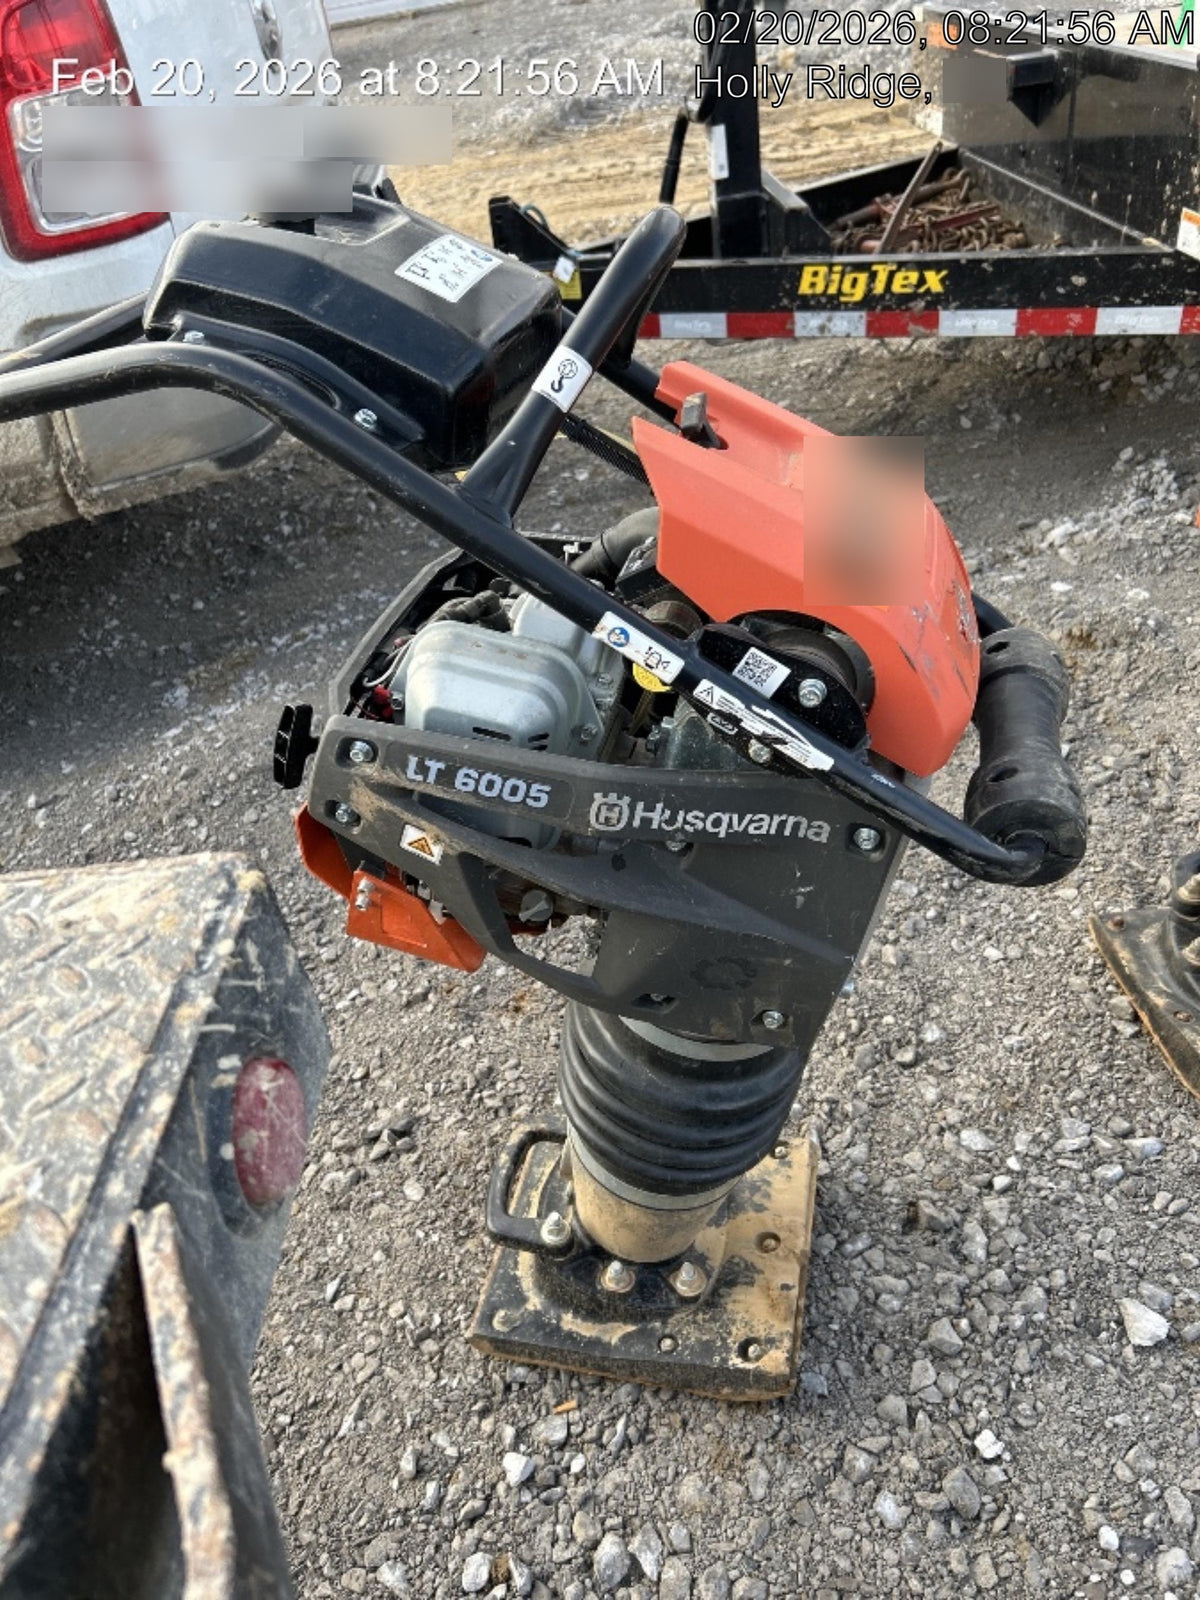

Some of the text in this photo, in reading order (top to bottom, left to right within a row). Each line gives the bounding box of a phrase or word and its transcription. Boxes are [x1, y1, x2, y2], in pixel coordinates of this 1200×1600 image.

[798, 264, 948, 302] BigTex
[406, 755, 552, 808] LT 6005
[632, 801, 832, 843] Husqvarna
